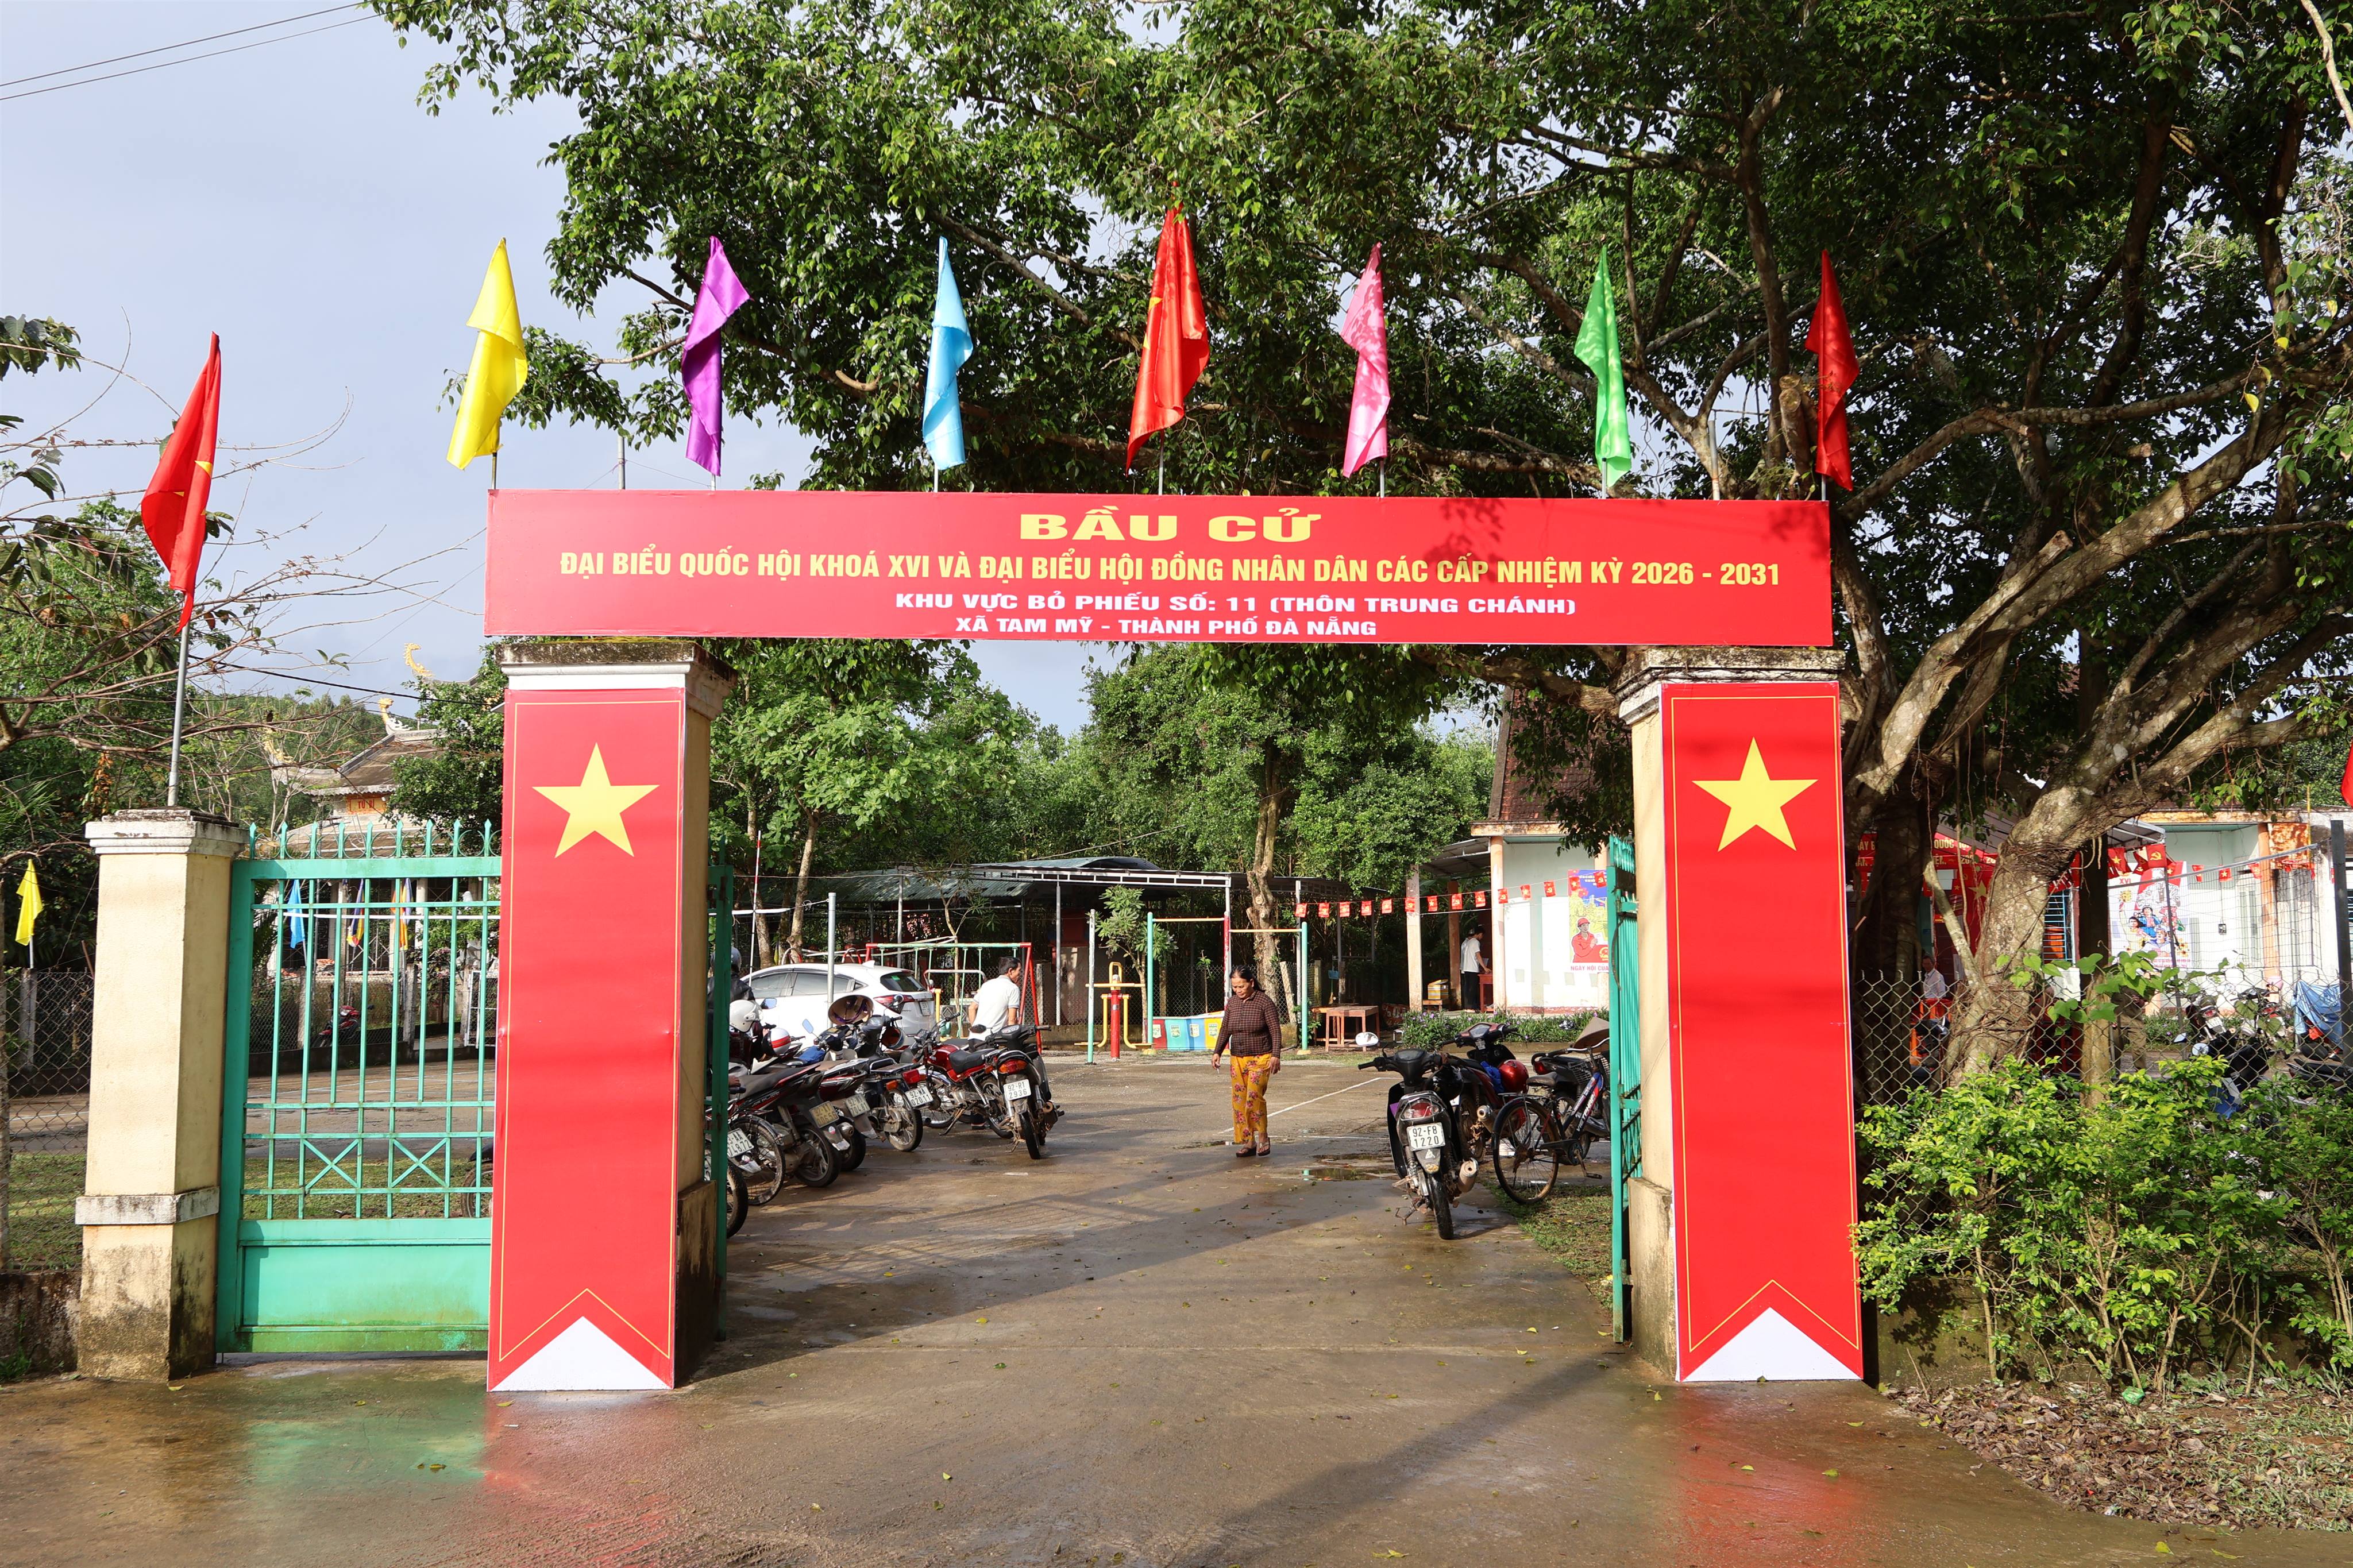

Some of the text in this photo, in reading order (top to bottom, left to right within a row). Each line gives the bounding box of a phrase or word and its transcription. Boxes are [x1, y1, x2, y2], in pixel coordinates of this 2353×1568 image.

[1020, 505, 1321, 542] BẦU CỬ
[561, 553, 603, 580] ĐẠI
[613, 543, 670, 574] BIỂU
[680, 545, 749, 577] QUỐC
[758, 550, 800, 581] HỘI
[810, 550, 879, 577] KHOÁ
[889, 555, 929, 577] XVI
[939, 551, 970, 578] VÀ
[979, 557, 1023, 584] ĐẠI
[1032, 549, 1090, 580] BIỂU
[1100, 553, 1142, 585] HỘI
[1151, 551, 1222, 581] ĐỒNG
[1232, 554, 1305, 581] NHÂN
[1314, 555, 1367, 581] DÂN
[1377, 555, 1428, 582] CÁC
[1437, 553, 1488, 582] CẤP
[1498, 557, 1581, 588] NHIỆM
[1591, 557, 1622, 584] KỲ
[1631, 562, 1694, 584] 2026
[1721, 563, 1778, 585] 2031
[896, 592, 1575, 615] KHU VỰC BỎ PHIẾU SỐ: 11 (THÔN TRUNG CHÁNH)
[956, 616, 988, 631] XÃ
[997, 619, 1046, 632] TAM
[1057, 617, 1092, 632] MỸ
[1118, 617, 1199, 634] THÀNH
[1209, 616, 1257, 634] PHỐ
[1266, 618, 1299, 635] ĐÀ
[1307, 617, 1376, 635] NẴNG
[1008, 1082, 1025, 1092] 92-R1
[1009, 1088, 1027, 1099] 2936
[1413, 1126, 1437, 1137] 92-F8
[1414, 1136, 1439, 1148] 1220
